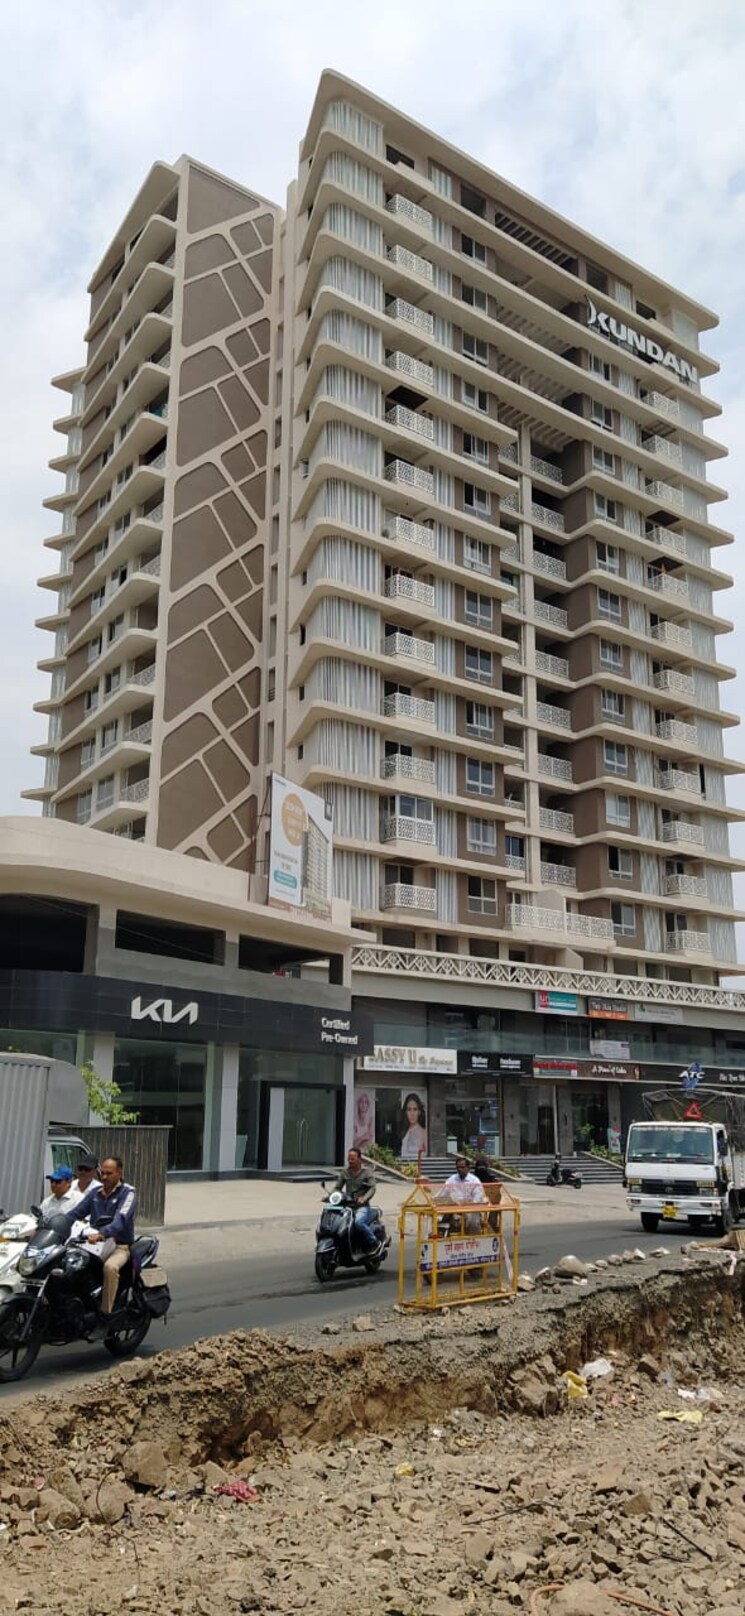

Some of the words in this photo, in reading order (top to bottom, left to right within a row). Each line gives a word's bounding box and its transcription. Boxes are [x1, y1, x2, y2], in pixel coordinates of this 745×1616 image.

[587, 296, 698, 383] KUNDAN
[131, 996, 199, 1025] KIA
[321, 1016, 351, 1030] Certified
[321, 1031, 359, 1045] Pre-Owned
[678, 1070, 706, 1079] ATC
